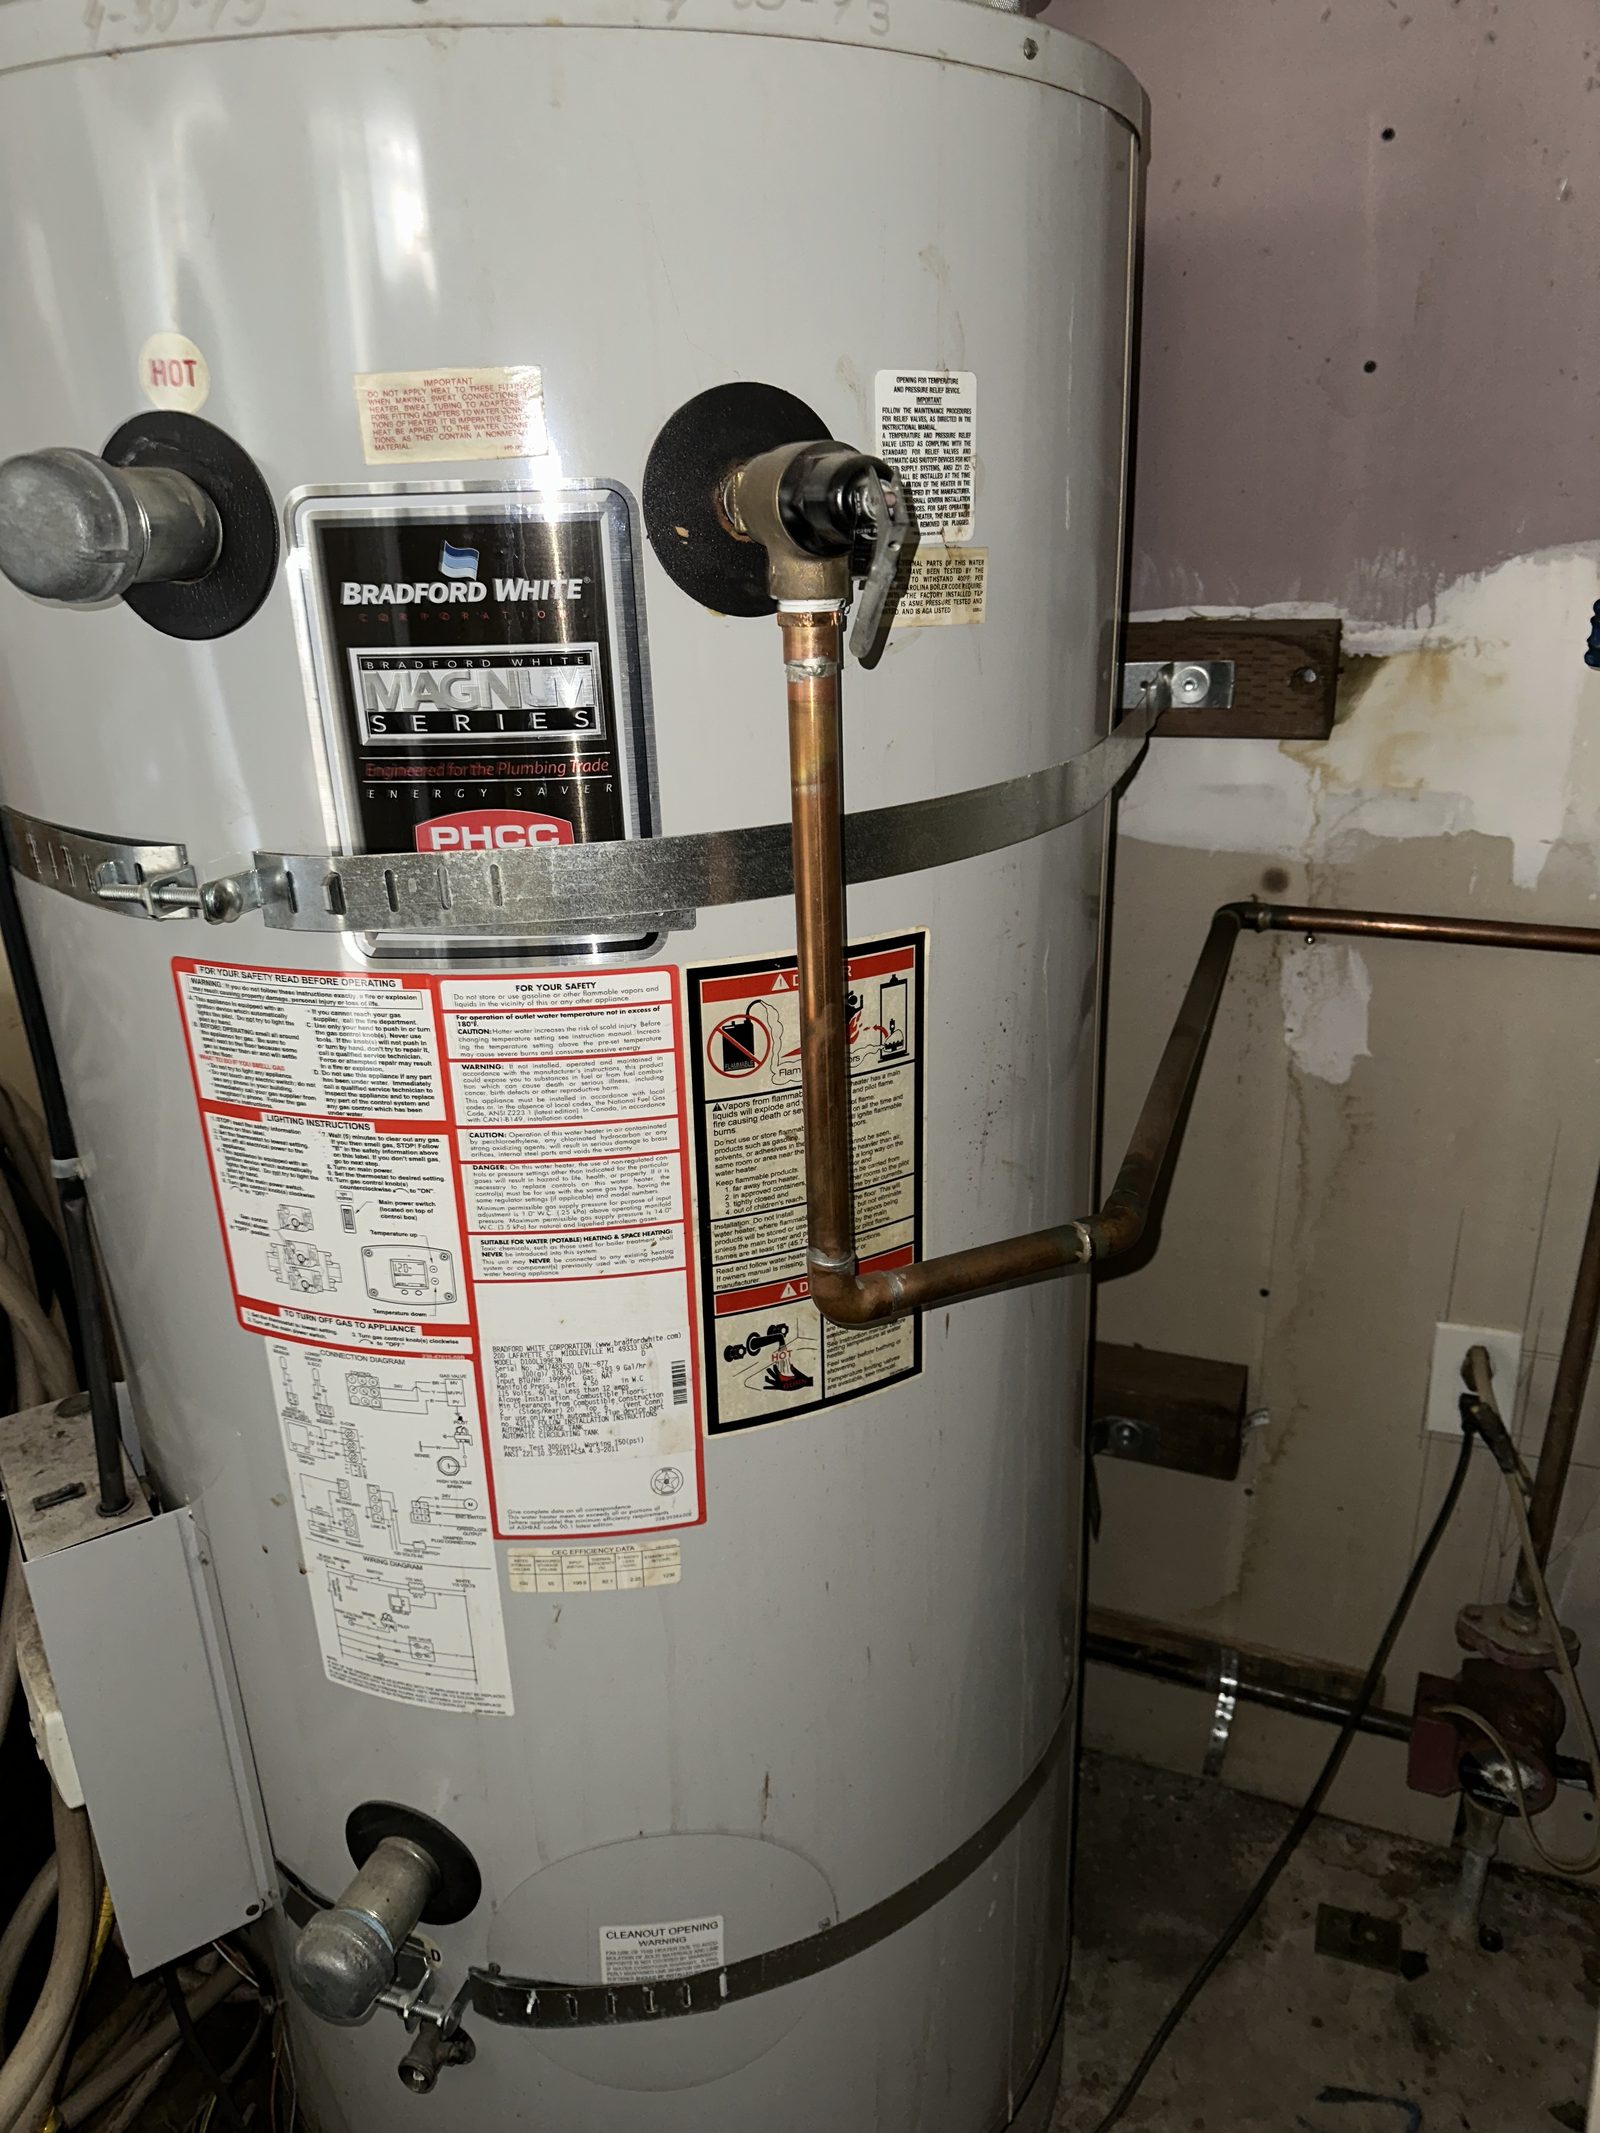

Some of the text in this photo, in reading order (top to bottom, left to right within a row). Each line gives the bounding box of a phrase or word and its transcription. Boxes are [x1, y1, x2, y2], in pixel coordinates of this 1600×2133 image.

[150, 359, 197, 387] HOT
[424, 378, 473, 386] IMPORTANT
[470, 384, 494, 392] THESE
[341, 581, 488, 606] BRADFORD
[366, 656, 584, 670] BRADFORD WHITE
[362, 666, 596, 712] MAGNUM
[371, 710, 590, 732] SERIES
[365, 758, 609, 780] Engineered for the Plumbing Trade
[367, 783, 613, 799] ENERGY SAVER
[430, 824, 560, 852] PHCC
[200, 966, 396, 988] FOR YOUR SAFETY READ BEFORE OPERATING
[566, 982, 596, 990] SAFETY
[470, 1014, 504, 1022] operation
[724, 1061, 754, 1071] FLAMMABLE
[712, 1111, 738, 1120] liquids
[754, 1104, 784, 1114] explode
[786, 1100, 800, 1108] and
[722, 1097, 770, 1111] Vapors from
[267, 1116, 370, 1130] LIGHTING INSTRUCTIONS
[713, 1120, 726, 1128] fire
[728, 1116, 758, 1126] causing
[760, 1112, 781, 1121] death
[714, 1128, 736, 1136] burns
[735, 1173, 769, 1184] flammable
[744, 1182, 761, 1190] away
[733, 1198, 752, 1207] tightly
[754, 1194, 776, 1203] closed
[741, 1189, 772, 1199] approved
[370, 1230, 408, 1238] Temperature
[372, 1308, 409, 1317] Temperature
[297, 1312, 317, 1322] TURN
[318, 1315, 333, 1324] OFF
[336, 1319, 352, 1327] GAS
[368, 1323, 416, 1333] APPLIANCE
[320, 1349, 370, 1362] CONNECTION
[370, 1355, 405, 1365] DIAGRAM
[771, 1350, 792, 1362] HOT
[570, 1547, 614, 1555] EFFICIENCY
[363, 1555, 423, 1570] WIRING DIAGRAM
[606, 1921, 718, 1940] CLEANOUT OPENING
[638, 1937, 687, 1948] WARNING
